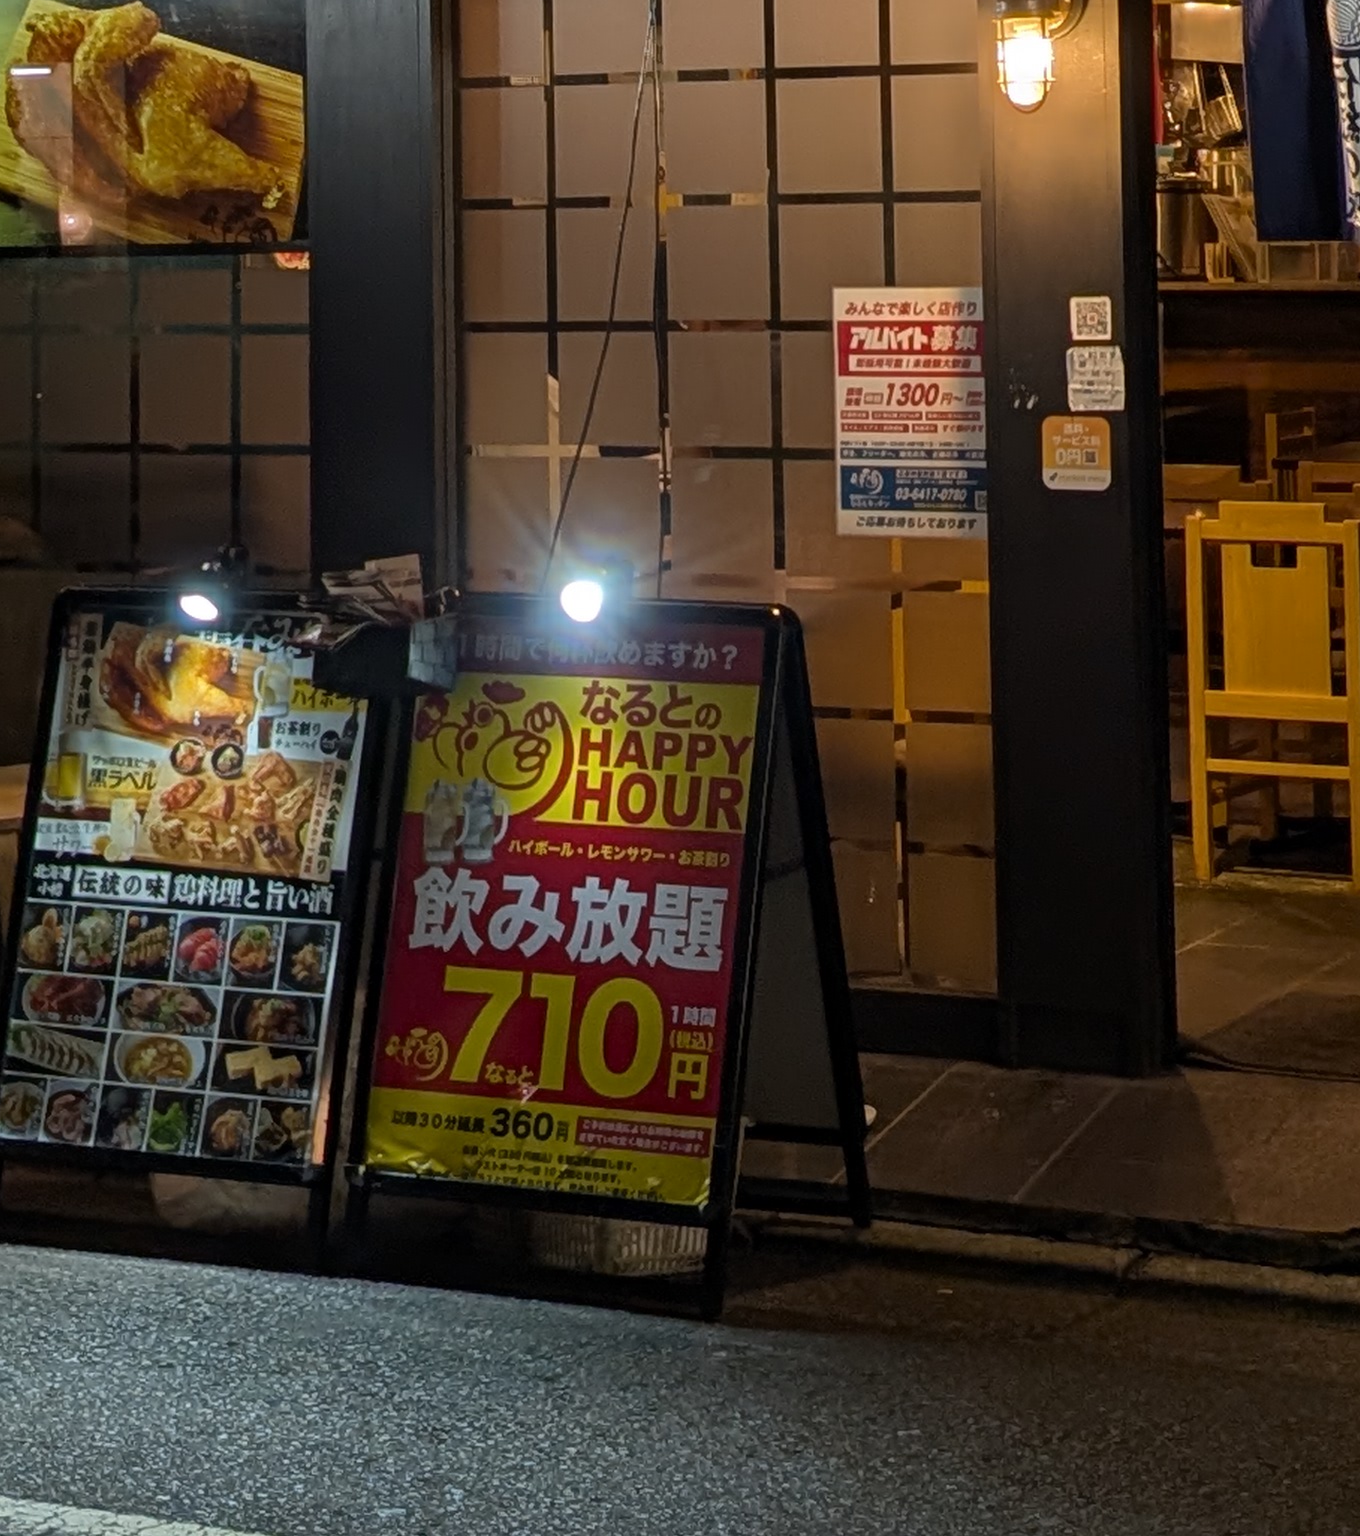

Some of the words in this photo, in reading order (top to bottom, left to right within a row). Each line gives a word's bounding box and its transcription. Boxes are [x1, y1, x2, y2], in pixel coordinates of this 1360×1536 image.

[580, 680, 722, 730] なるとの
[578, 727, 754, 776] HAPPY
[88, 768, 158, 791] 黒ラベル
[571, 770, 745, 831] HOUR
[78, 869, 165, 898] 伝統の味
[408, 866, 729, 972] 飲み放題
[443, 964, 664, 1099] 710
[670, 1006, 717, 1028] 1時間
[667, 1053, 710, 1101] 円
